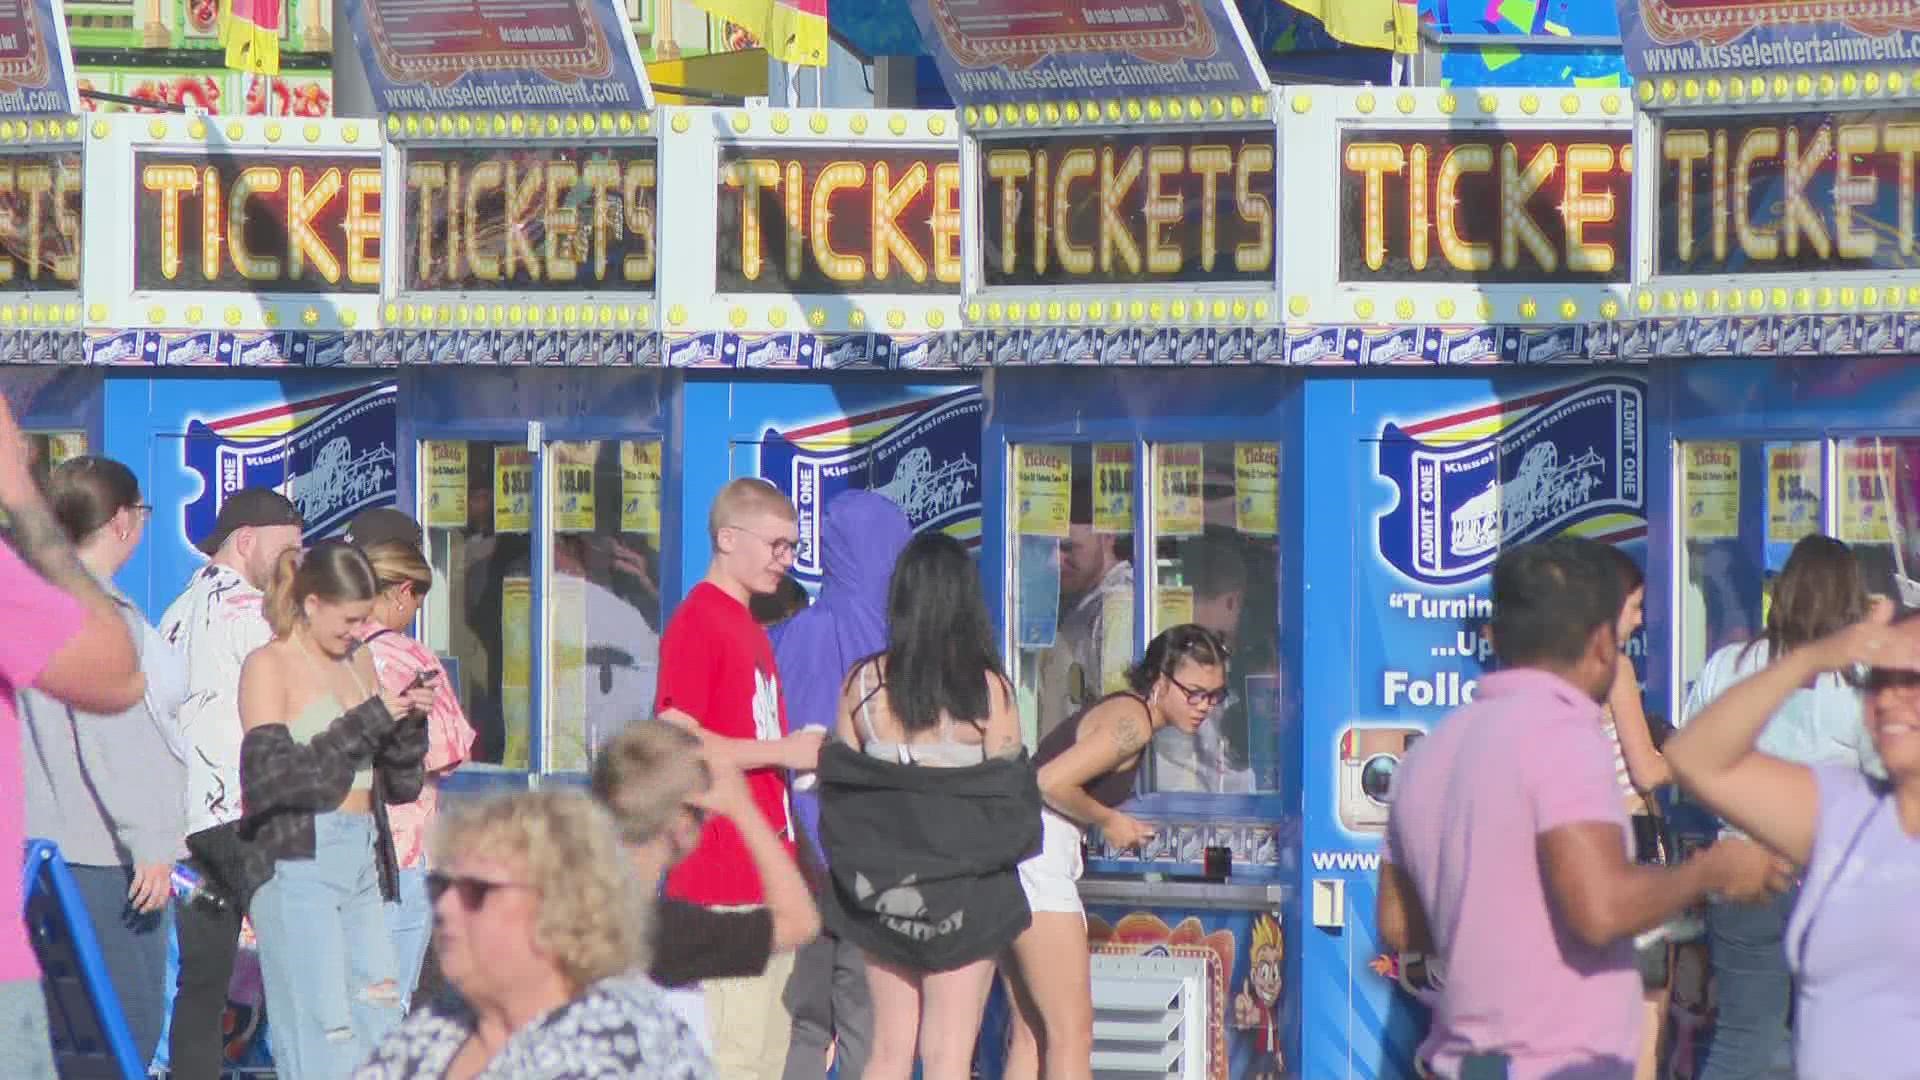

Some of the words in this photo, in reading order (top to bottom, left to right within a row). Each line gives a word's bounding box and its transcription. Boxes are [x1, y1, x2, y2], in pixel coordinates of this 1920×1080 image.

[383, 80, 630, 109] www.kisselentertainment.com
[955, 60, 1239, 92] www.kisselentertainment.com
[407, 160, 656, 281] TICKETS
[987, 145, 1273, 274] TICKETS
[1345, 141, 1632, 272] TICKE
[1443, 449, 1497, 474] Kissel
[1500, 392, 1615, 457] Entertainment
[1622, 397, 1637, 454] ADMIT
[223, 457, 237, 493] ONE
[245, 446, 296, 467] Kissel
[1622, 456, 1637, 495] ONE
[799, 467, 813, 505] ONE
[1419, 463, 1434, 502] ONE
[799, 507, 813, 562] ADMIT
[1419, 505, 1435, 565] ADMIT
